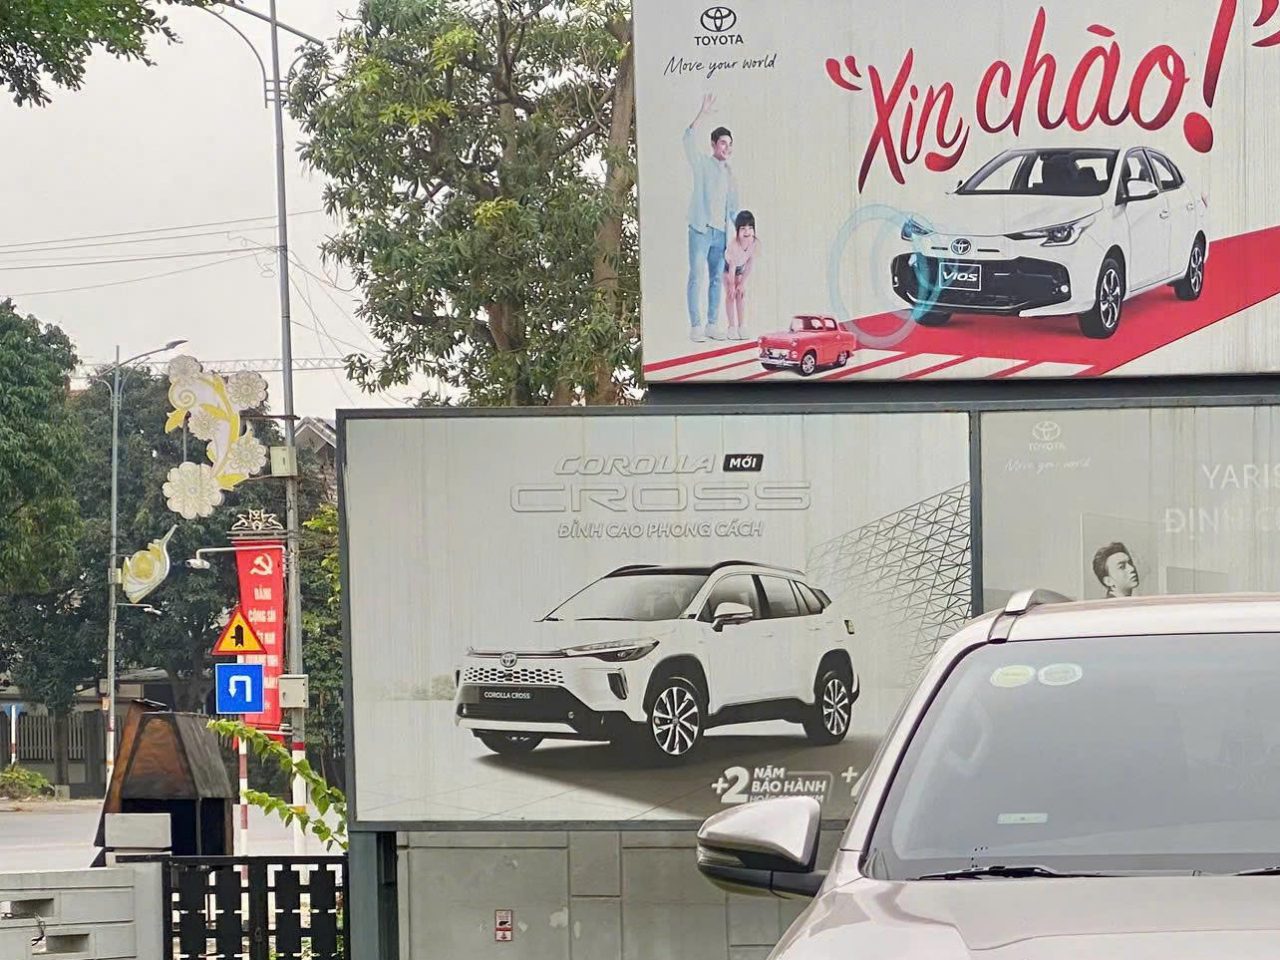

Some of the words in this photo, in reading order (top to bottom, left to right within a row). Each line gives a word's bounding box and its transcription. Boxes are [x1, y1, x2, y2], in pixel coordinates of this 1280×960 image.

[694, 34, 744, 46] TOYOTA
[664, 56, 704, 75] Move
[707, 61, 738, 79] your
[742, 53, 777, 69] world
[943, 272, 978, 281] VIOS
[554, 454, 715, 476] COROLLA
[729, 455, 756, 469] MỚI
[510, 481, 811, 513] CROSS
[605, 522, 644, 538] CAO
[647, 522, 710, 538] PHONG
[715, 519, 763, 537] CÁCH
[484, 691, 510, 699] COROLLA
[511, 692, 531, 700] CROSS
[753, 765, 785, 779] NĂM
[784, 778, 827, 792] HÀNH
